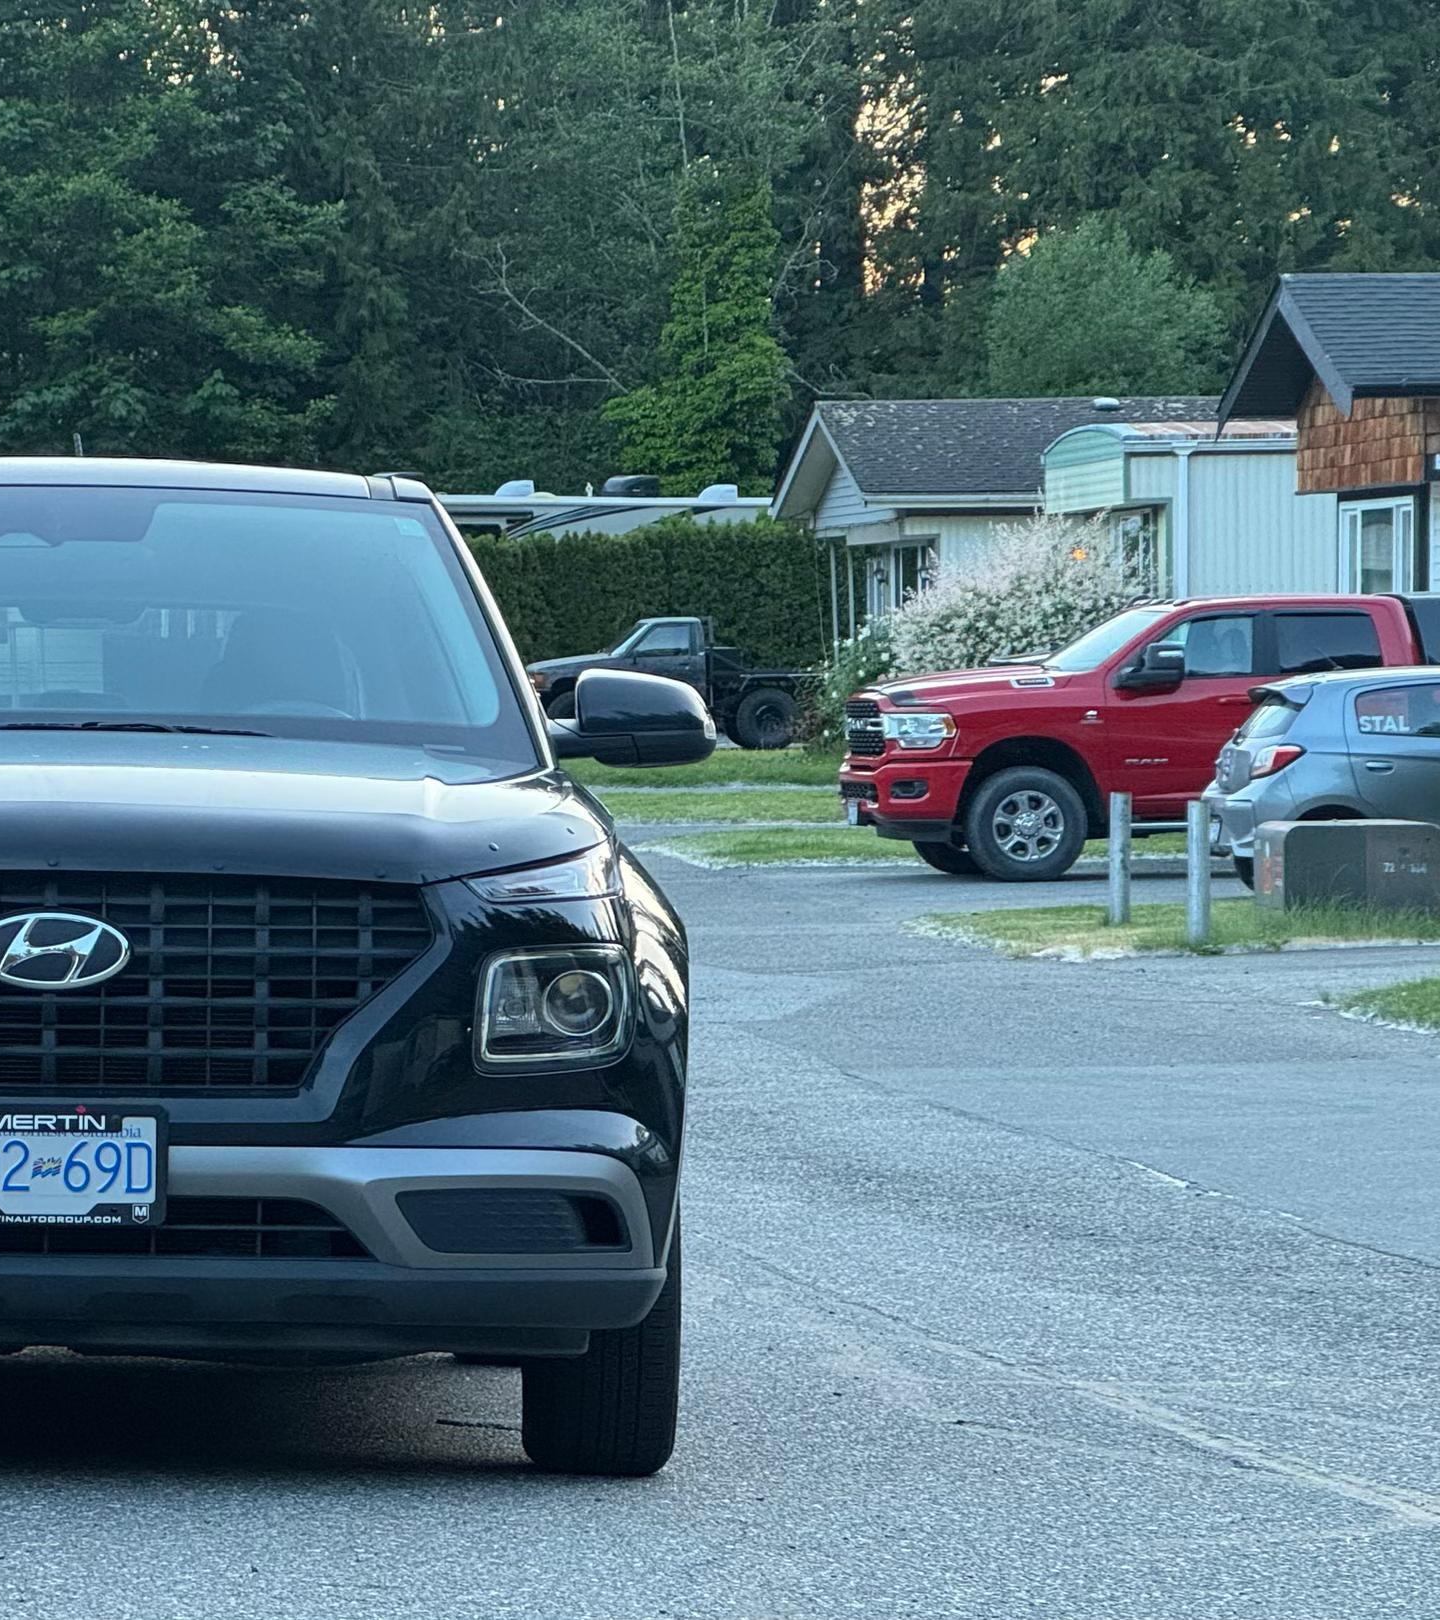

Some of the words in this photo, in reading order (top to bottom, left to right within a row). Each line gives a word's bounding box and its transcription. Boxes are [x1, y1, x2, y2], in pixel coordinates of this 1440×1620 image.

[1359, 715, 1410, 732] STAL
[63, 1141, 153, 1193] 69D
[134, 1206, 147, 1217] M
